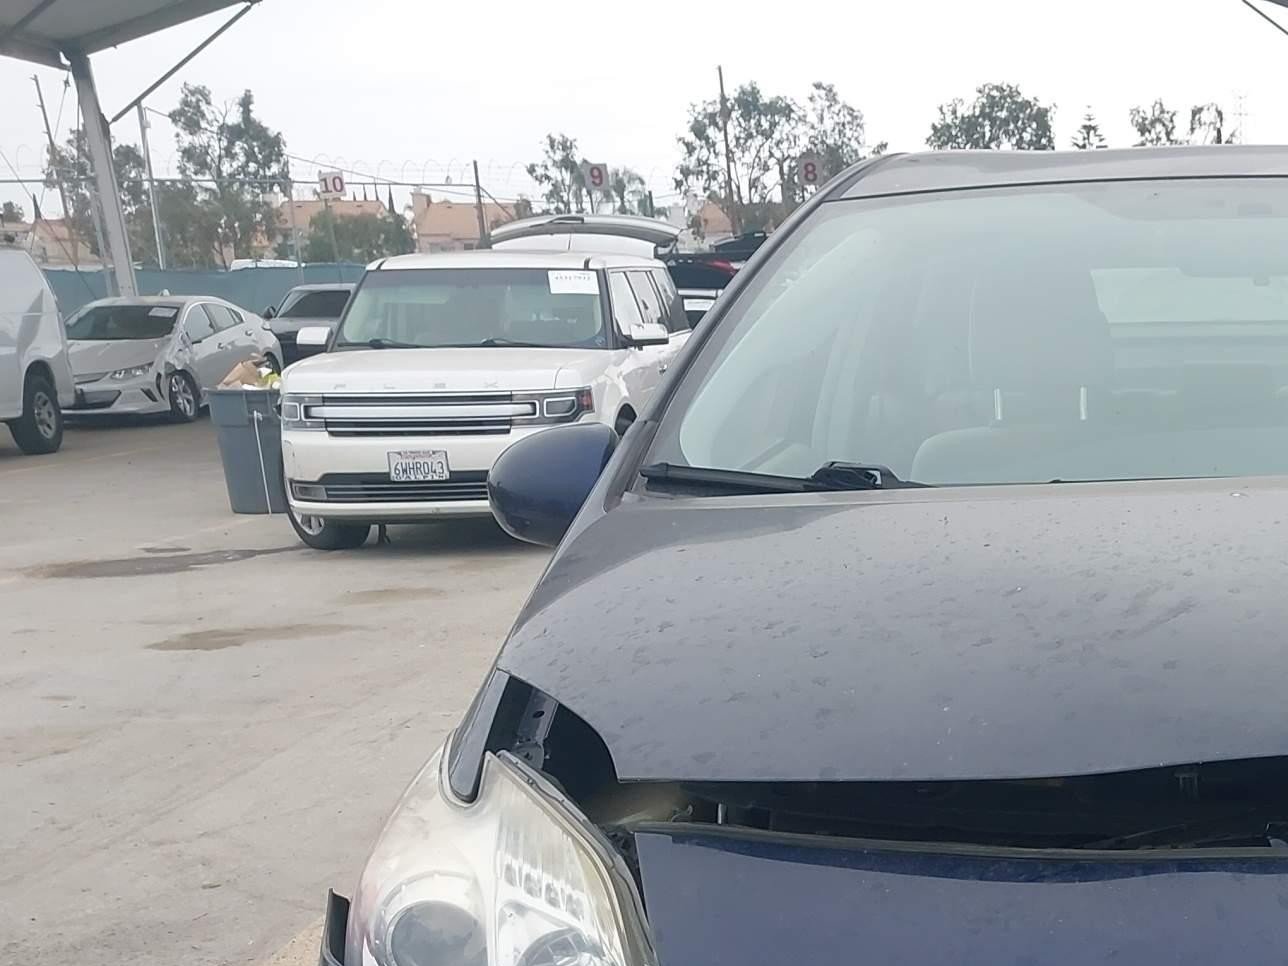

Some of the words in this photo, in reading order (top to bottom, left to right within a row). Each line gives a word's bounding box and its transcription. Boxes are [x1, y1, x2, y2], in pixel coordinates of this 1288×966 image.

[590, 166, 603, 187] 9
[804, 162, 817, 182] 8
[319, 176, 344, 193] 10
[393, 460, 445, 477] 6WHR043
